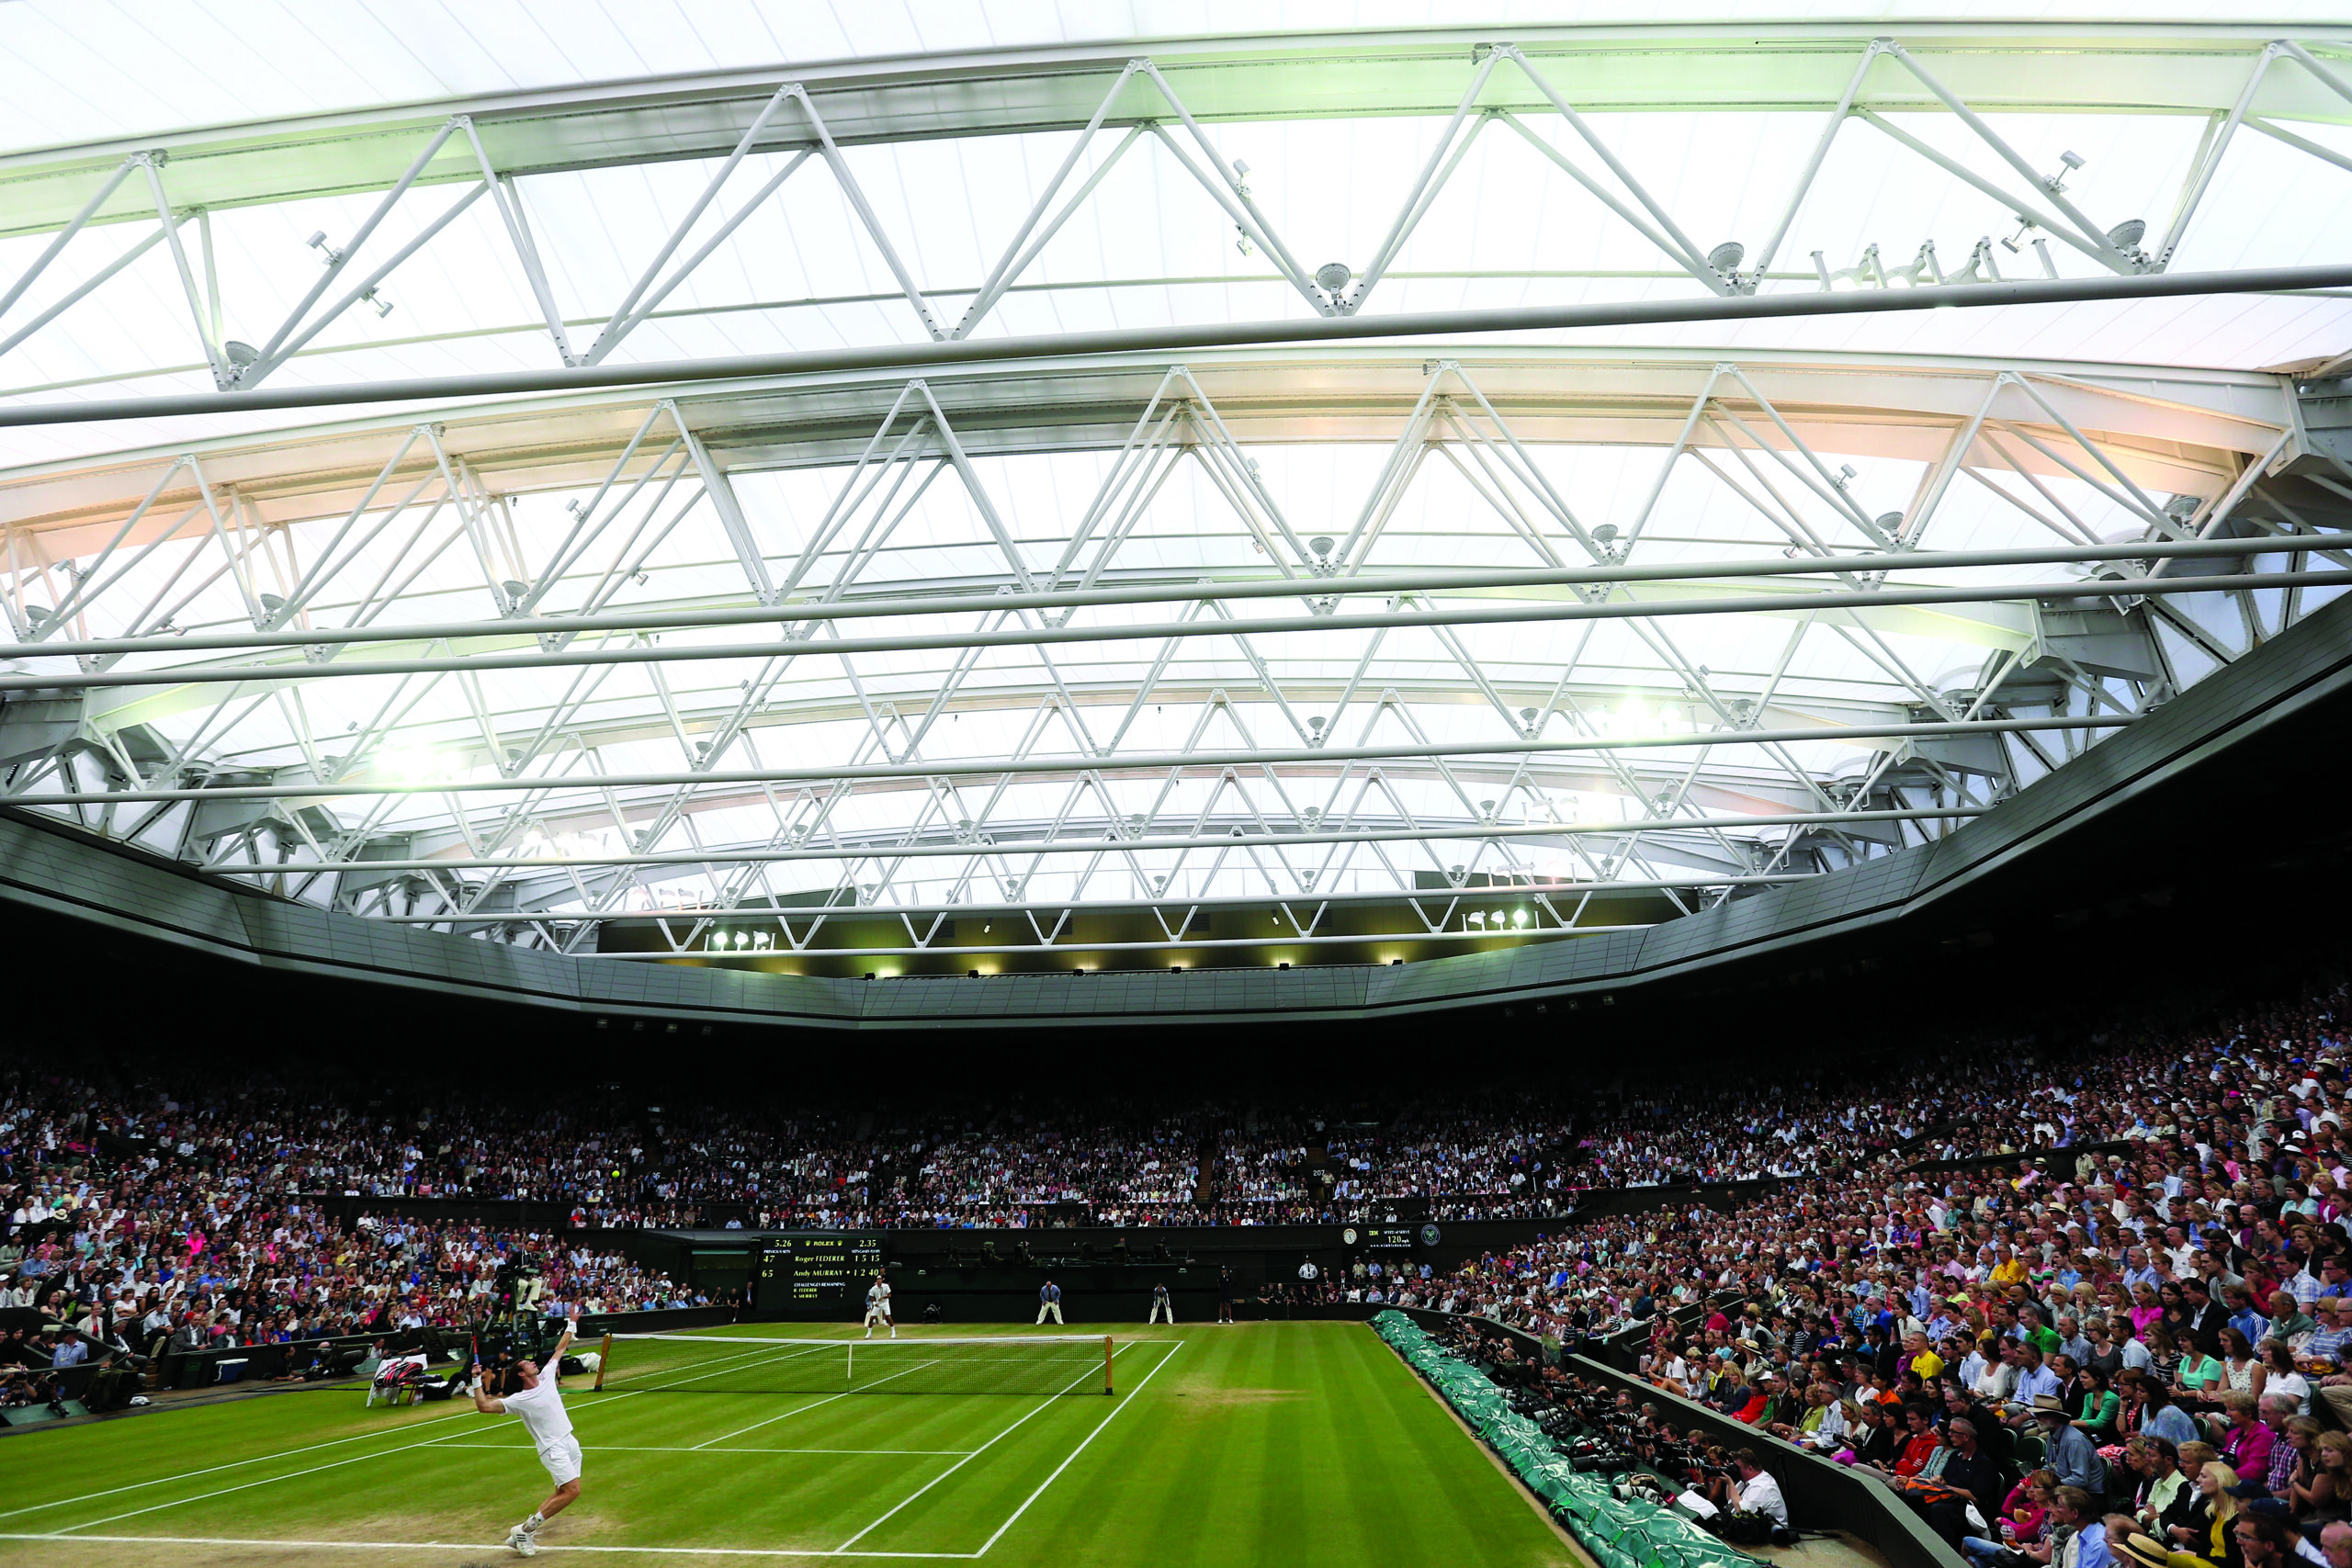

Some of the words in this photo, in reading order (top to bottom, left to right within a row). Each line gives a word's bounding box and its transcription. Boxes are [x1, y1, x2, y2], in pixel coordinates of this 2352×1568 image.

[775, 1239, 792, 1247] 5.26
[859, 1239, 876, 1247] 2.35
[861, 1254, 867, 1262] 5
[871, 1254, 880, 1262] 15
[793, 1269, 811, 1278] Andy
[860, 1269, 866, 1277] 2
[868, 1269, 879, 1277] 40
